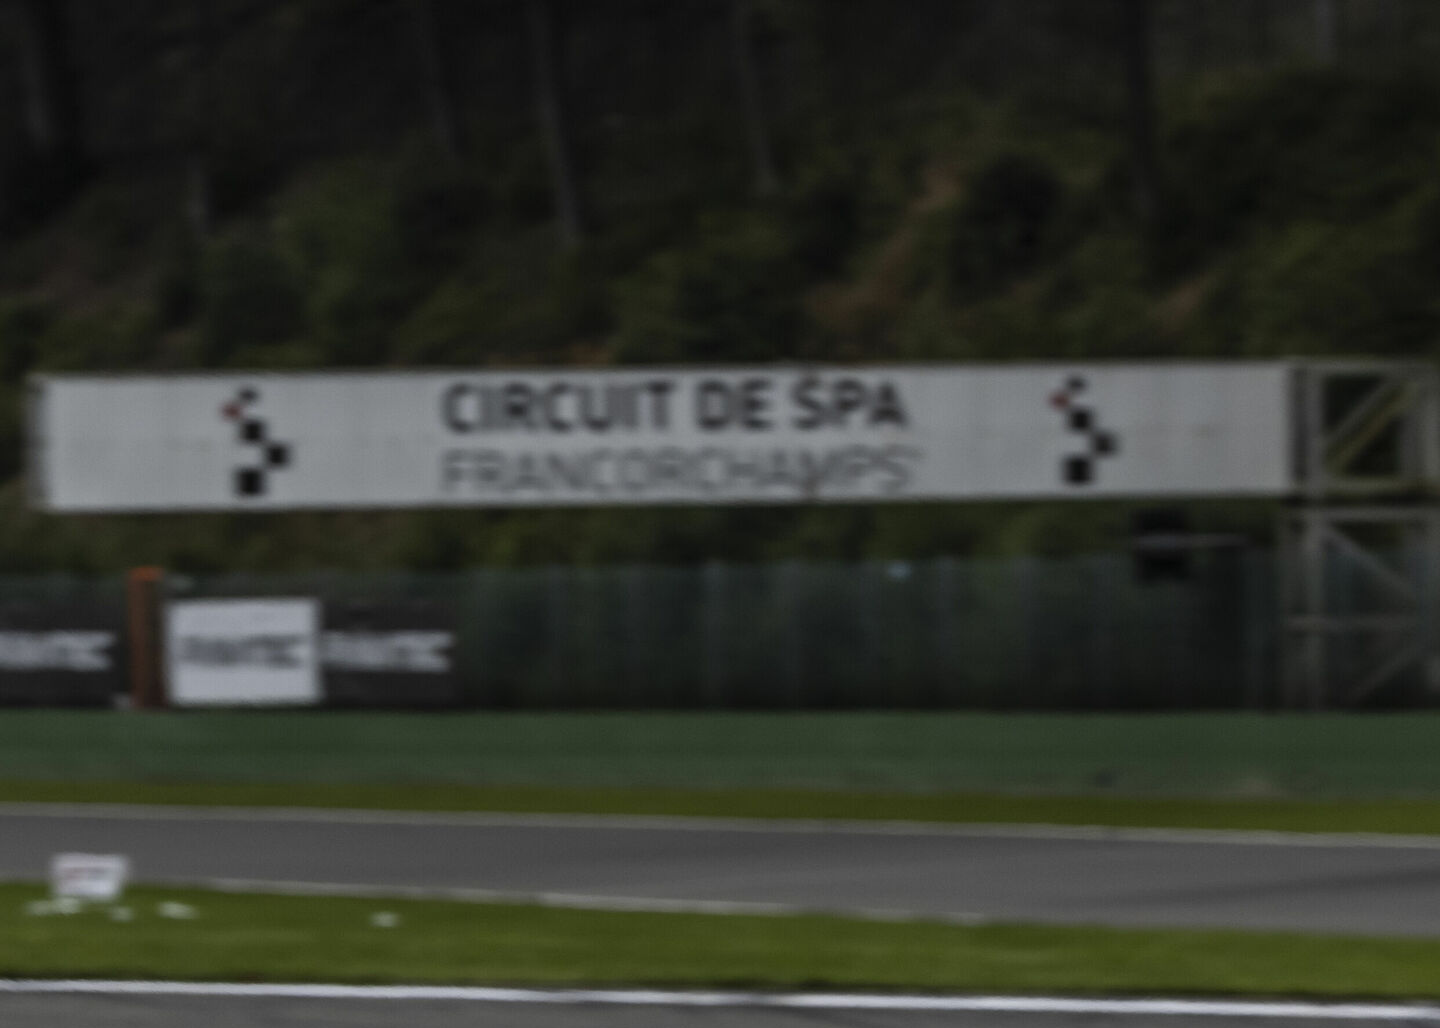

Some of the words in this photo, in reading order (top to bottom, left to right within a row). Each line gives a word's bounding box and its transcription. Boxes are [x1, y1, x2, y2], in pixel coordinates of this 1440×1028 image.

[444, 381, 674, 434] CIRCUIT
[696, 379, 773, 432] DE
[792, 376, 907, 430] SPA
